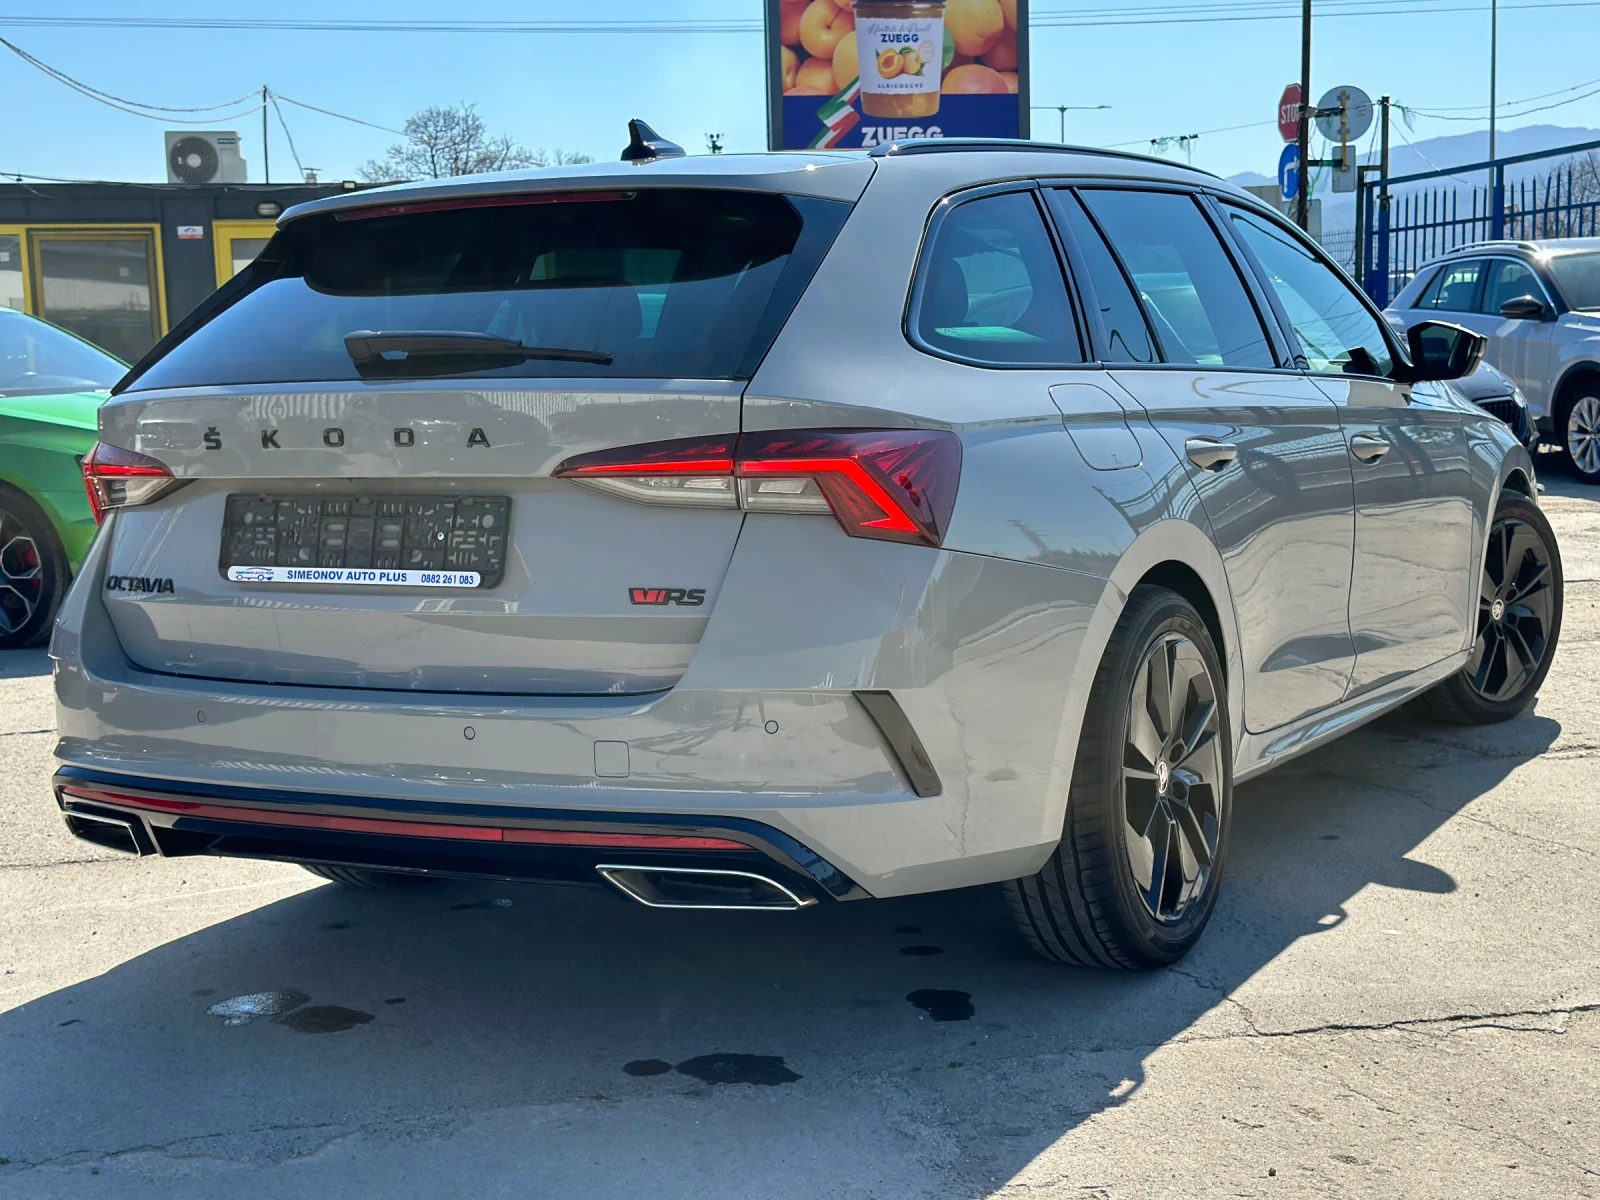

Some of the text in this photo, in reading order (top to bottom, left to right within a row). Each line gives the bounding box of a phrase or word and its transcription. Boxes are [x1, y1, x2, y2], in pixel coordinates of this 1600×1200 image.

[881, 34, 919, 43] ZUEGG
[106, 575, 175, 594] OCTAVIA
[287, 570, 474, 585] SIMEONOV AUTO PLUS 0882 261 083
